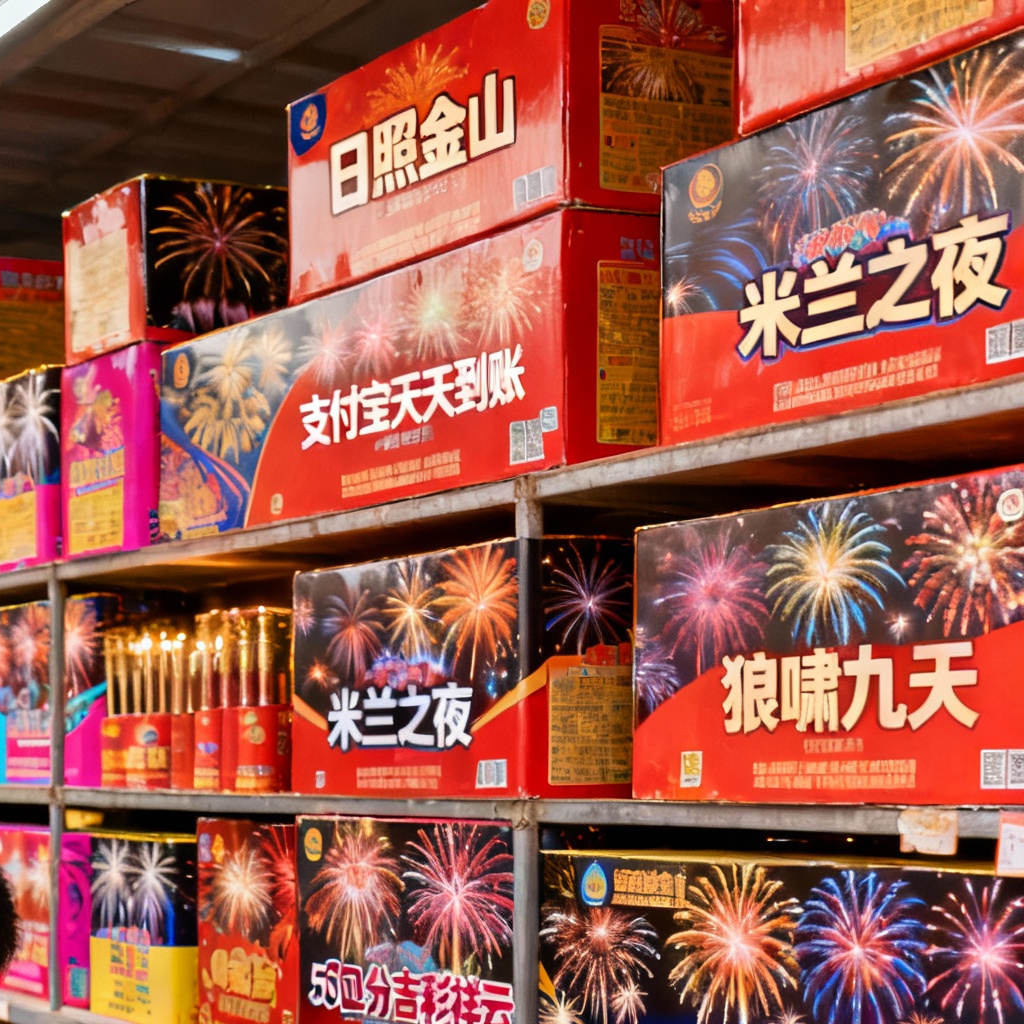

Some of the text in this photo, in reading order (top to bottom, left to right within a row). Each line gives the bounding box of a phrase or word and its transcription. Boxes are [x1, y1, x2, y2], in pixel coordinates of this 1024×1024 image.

[330, 71, 517, 216] 日照金山
[738, 211, 1012, 361] 米兰之夜
[299, 343, 525, 450] 支付宝天天到账
[327, 681, 473, 750] 米兰之夜
[721, 641, 980, 734] 狼啸九天
